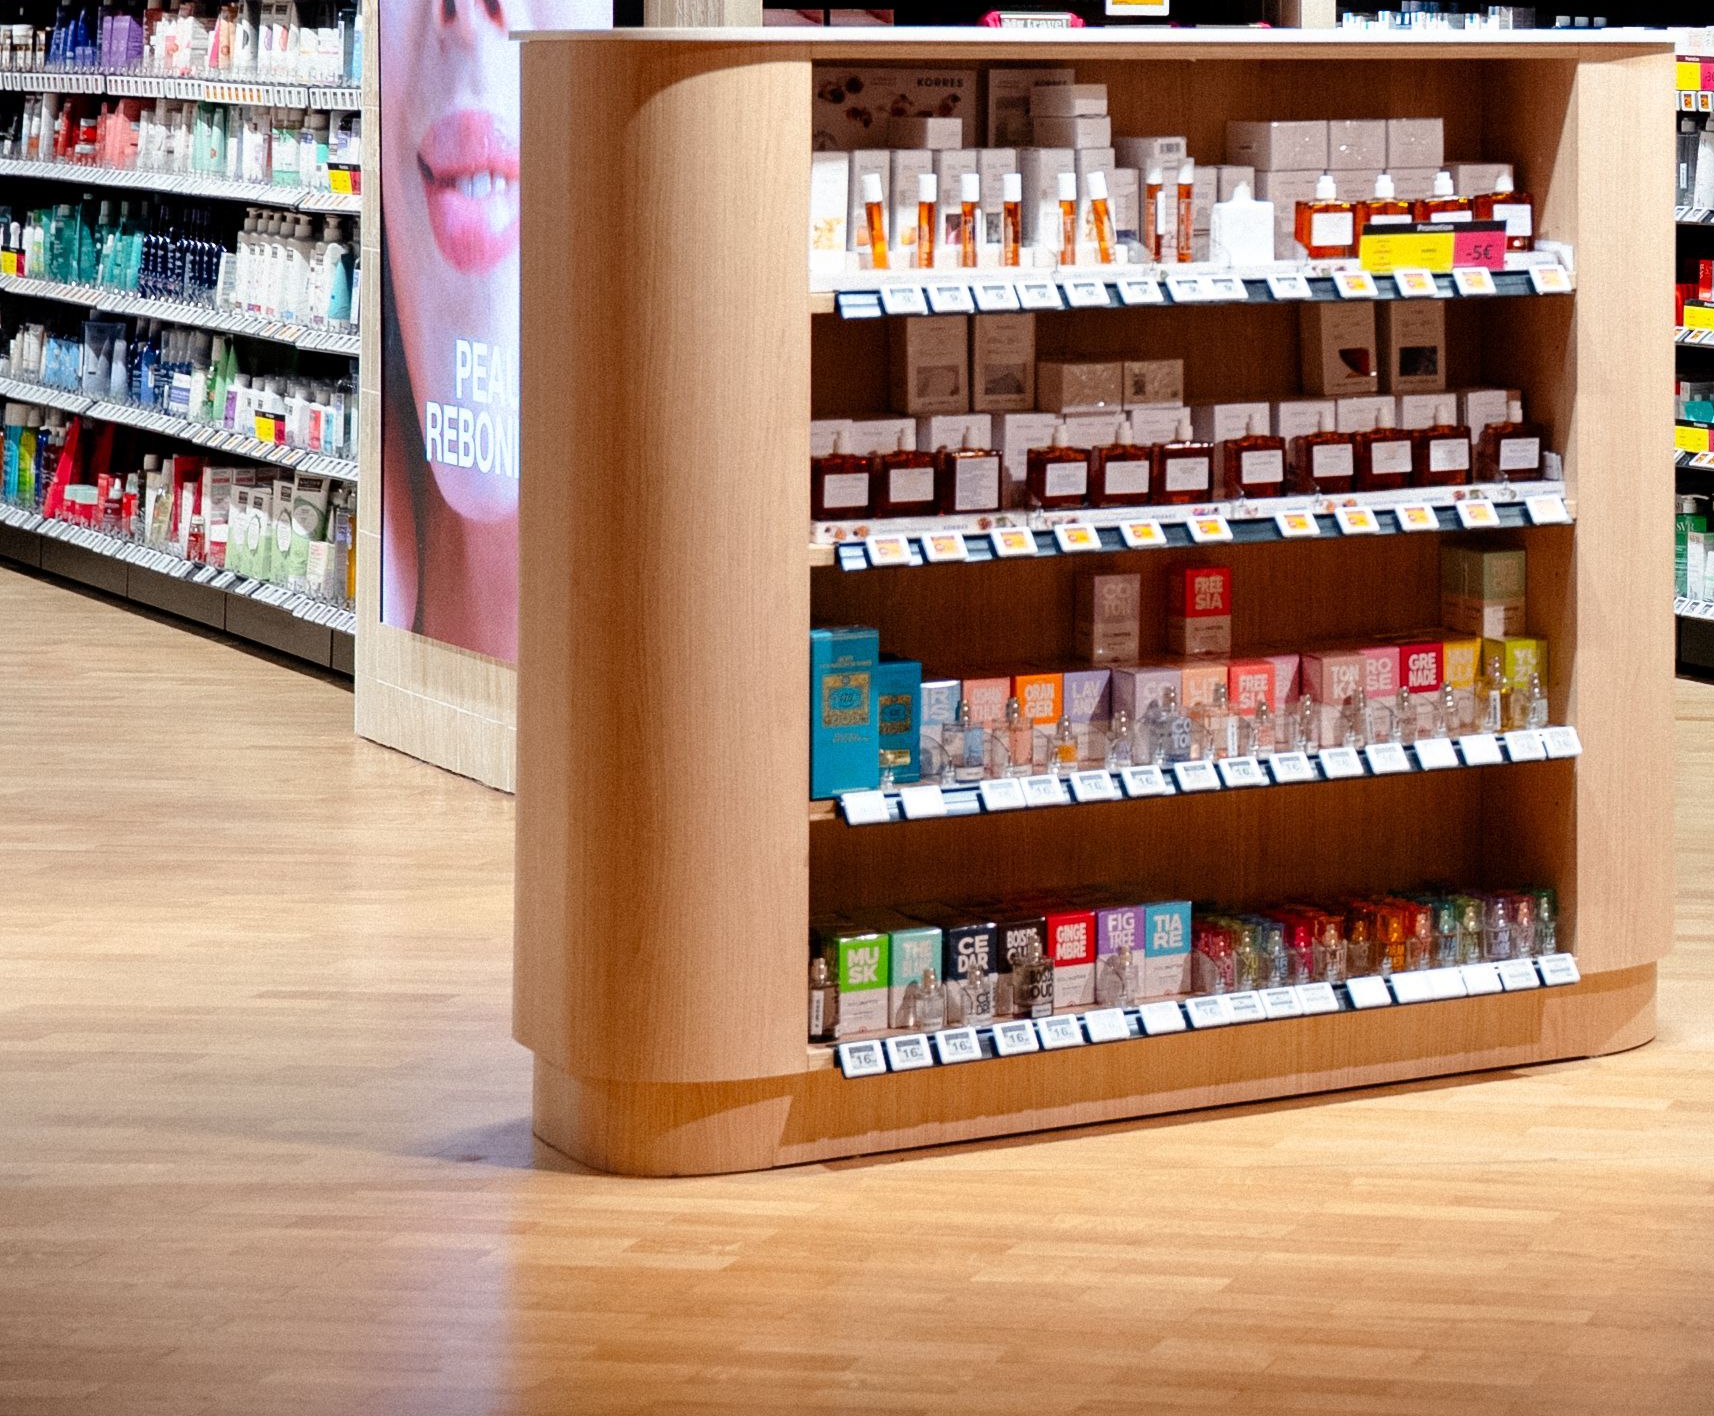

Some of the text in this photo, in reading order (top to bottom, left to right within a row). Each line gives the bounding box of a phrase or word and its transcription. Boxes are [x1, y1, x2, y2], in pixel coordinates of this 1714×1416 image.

[916, 77, 964, 88] KORRES
[1466, 243, 1494, 261] -5€
[1676, 520, 1695, 532] SVR
[1194, 593, 1223, 611] SIA
[1366, 657, 1392, 674] RO
[1408, 651, 1437, 671] GRE
[1238, 673, 1269, 692] FREE
[1331, 664, 1360, 682] TON
[1408, 669, 1437, 688] NADE
[1366, 675, 1392, 691] SE
[1023, 701, 1055, 719] GER
[1107, 912, 1136, 933] FIG
[1153, 914, 1183, 934] TIA
[1055, 922, 1087, 943] GINGE
[1108, 929, 1136, 949] TREE
[1153, 932, 1183, 950] RE
[957, 934, 990, 956] CE
[1055, 942, 1087, 961] MBRE
[847, 945, 880, 966] MU
[957, 954, 989, 974] DAR
[847, 965, 879, 985] SK
